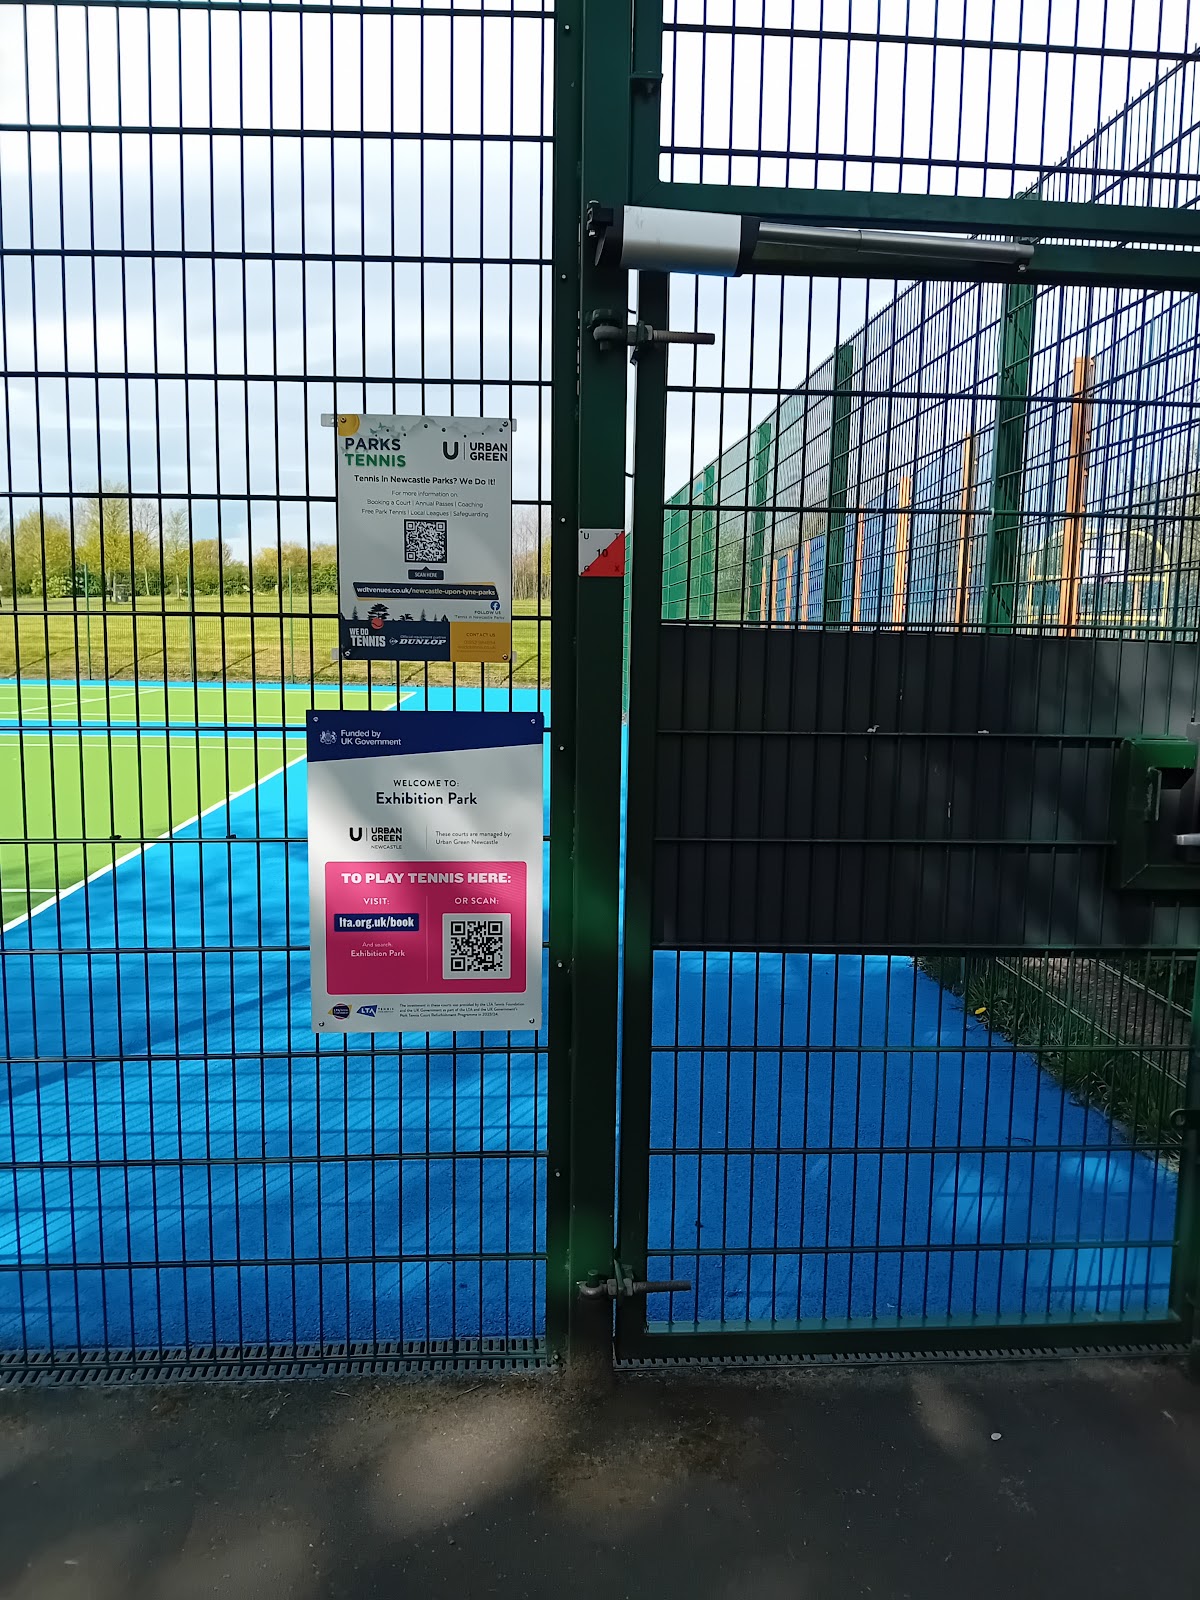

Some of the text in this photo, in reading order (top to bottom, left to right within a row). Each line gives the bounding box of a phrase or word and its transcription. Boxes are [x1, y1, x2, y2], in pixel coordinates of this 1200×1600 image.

[344, 437, 401, 451] PARKS
[469, 442, 508, 452] URBAN
[442, 441, 459, 460] U
[344, 453, 406, 468] TENNIS
[469, 452, 508, 462] GREEN
[354, 474, 380, 483] Tennis
[390, 476, 431, 485] Newcastle
[432, 477, 458, 485] Parks?
[474, 478, 487, 486] Do
[367, 498, 390, 506] Booking
[452, 510, 489, 518] Safeguarding
[596, 548, 609, 558] 10
[349, 628, 369, 636] WE DO
[350, 636, 386, 648] TENNIS
[399, 638, 447, 646] DUNLOP
[340, 730, 382, 739] Funded by
[340, 738, 402, 746] UK Government
[393, 779, 441, 787] WELCOME
[376, 792, 478, 806] Exhibition Park
[350, 826, 363, 842] U
[371, 826, 403, 835] URBAN
[371, 834, 403, 842] GREEN
[479, 832, 503, 840] managed
[341, 872, 512, 884] TO PLAY TENNIS HERE:
[363, 897, 390, 905] VISIT:
[454, 897, 500, 905] OR SCAN:
[339, 916, 415, 930] lta.org.uk/book
[350, 950, 406, 958] Exhibition Park
[361, 1008, 376, 1016] LTA
